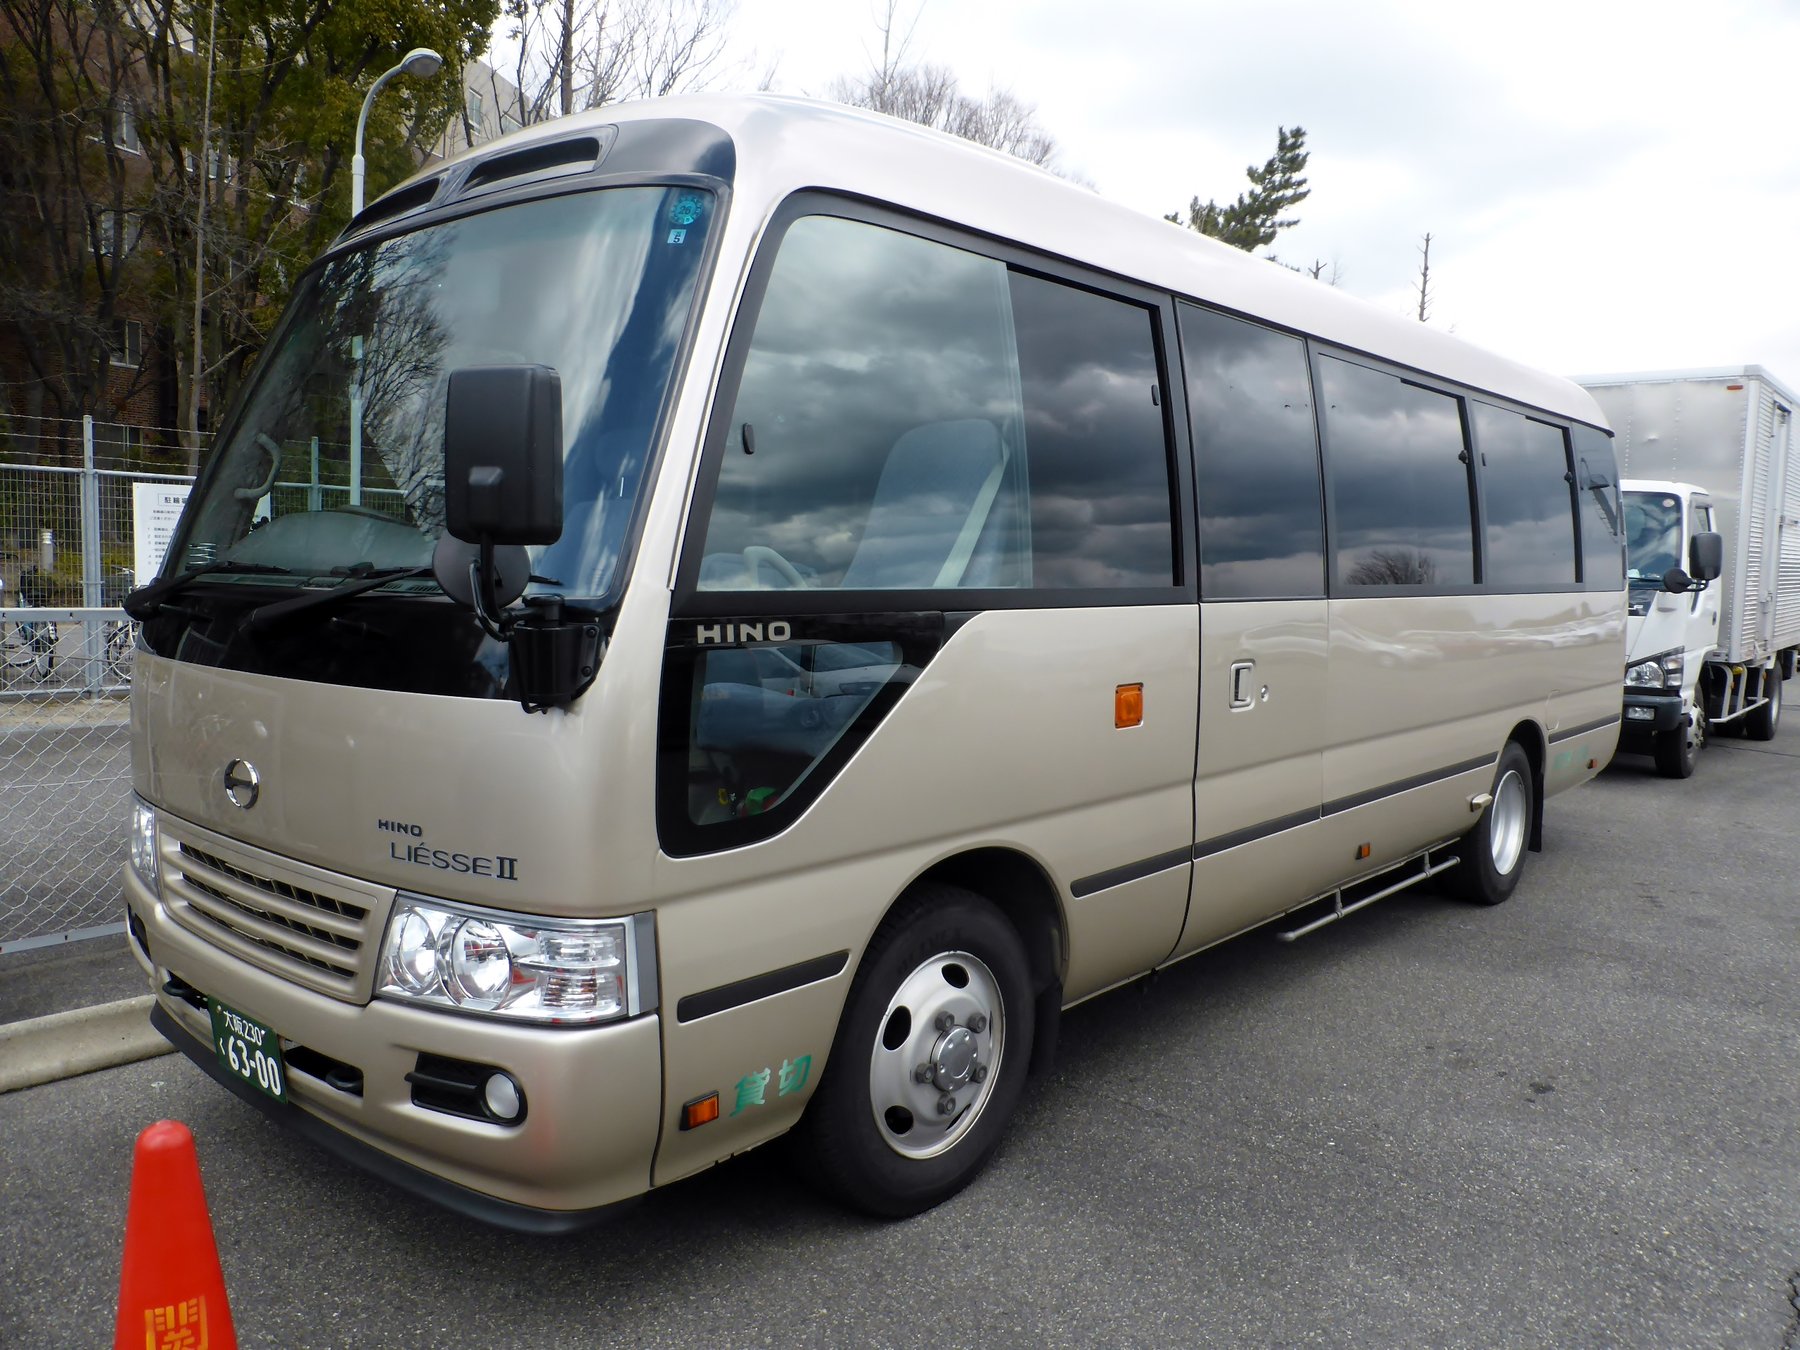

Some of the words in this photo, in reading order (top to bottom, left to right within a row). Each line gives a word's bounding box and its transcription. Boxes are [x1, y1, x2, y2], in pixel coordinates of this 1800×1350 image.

[697, 621, 791, 644] HINO
[378, 819, 423, 837] HINO
[228, 1035, 282, 1096] 63-00
